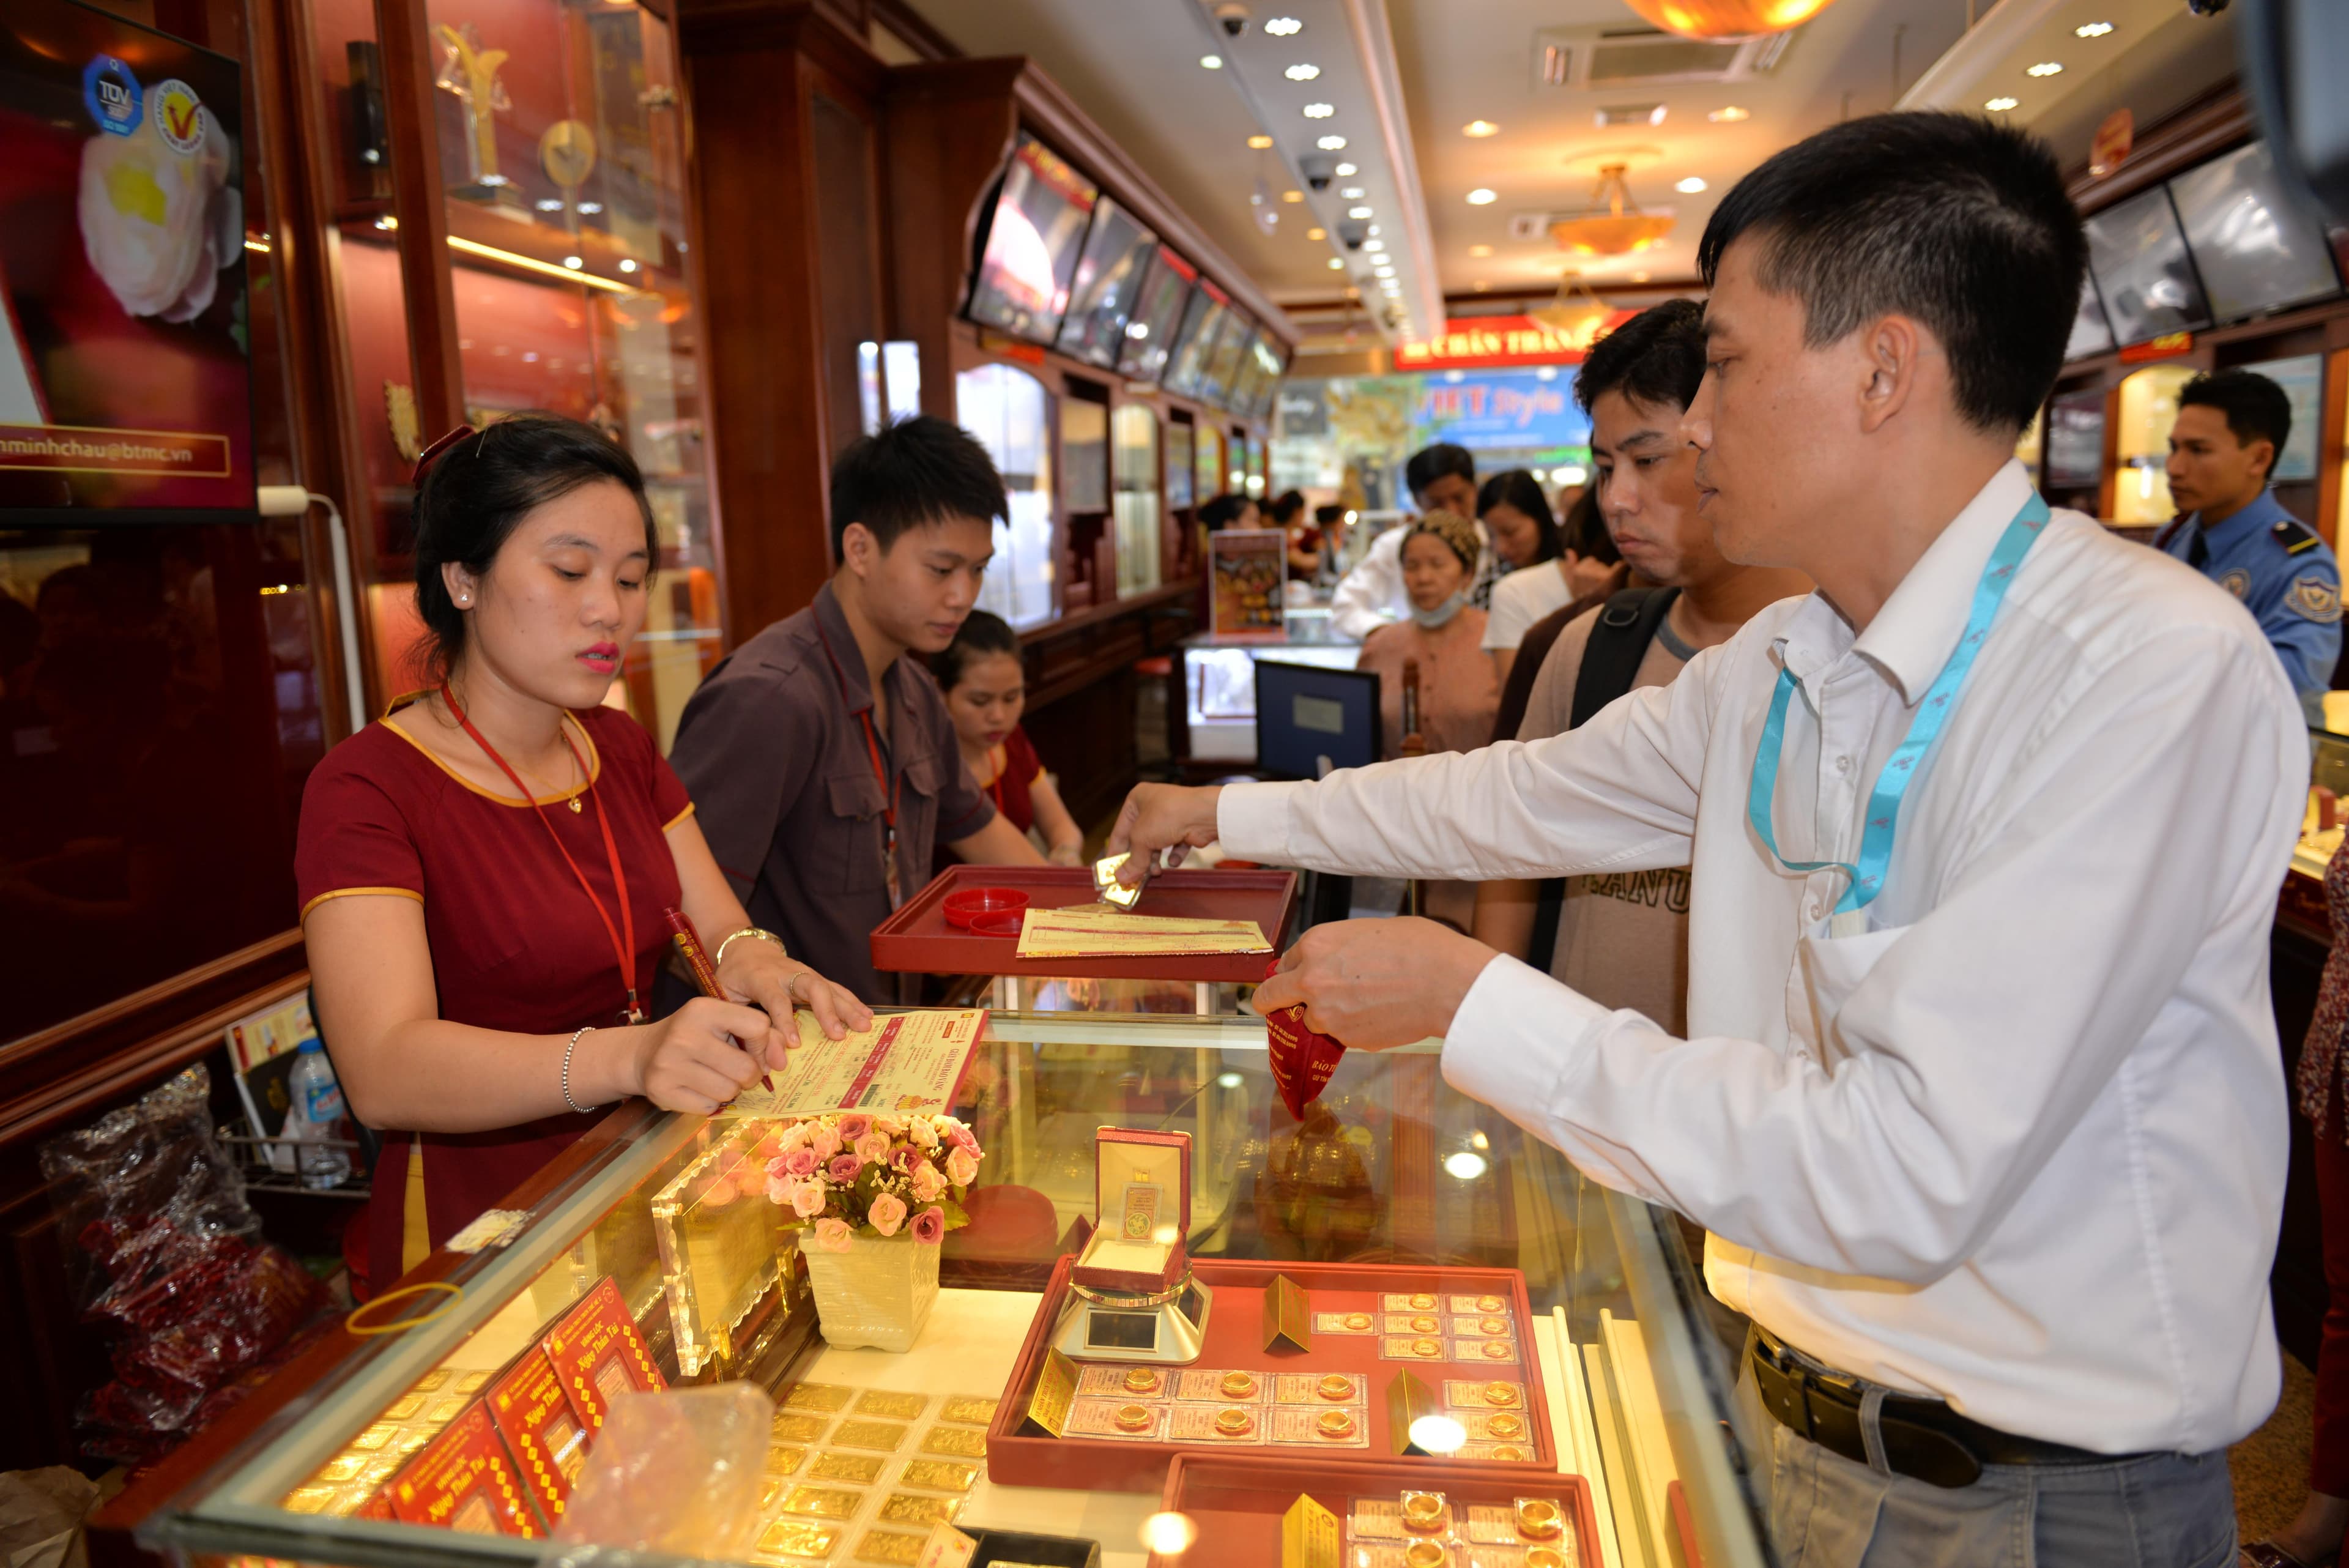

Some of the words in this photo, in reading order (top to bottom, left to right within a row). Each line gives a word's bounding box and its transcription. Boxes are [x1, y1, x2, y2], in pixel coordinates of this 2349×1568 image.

[1312, 1060, 1329, 1071] BẢO
[1328, 1062, 1338, 1072] TÍ
[577, 1350, 596, 1372] Ngày
[592, 1335, 610, 1354] Thần
[606, 1321, 619, 1338] Tài
[524, 1403, 547, 1429] Ngày
[543, 1384, 562, 1407] Thần
[469, 1454, 486, 1474] Tài
